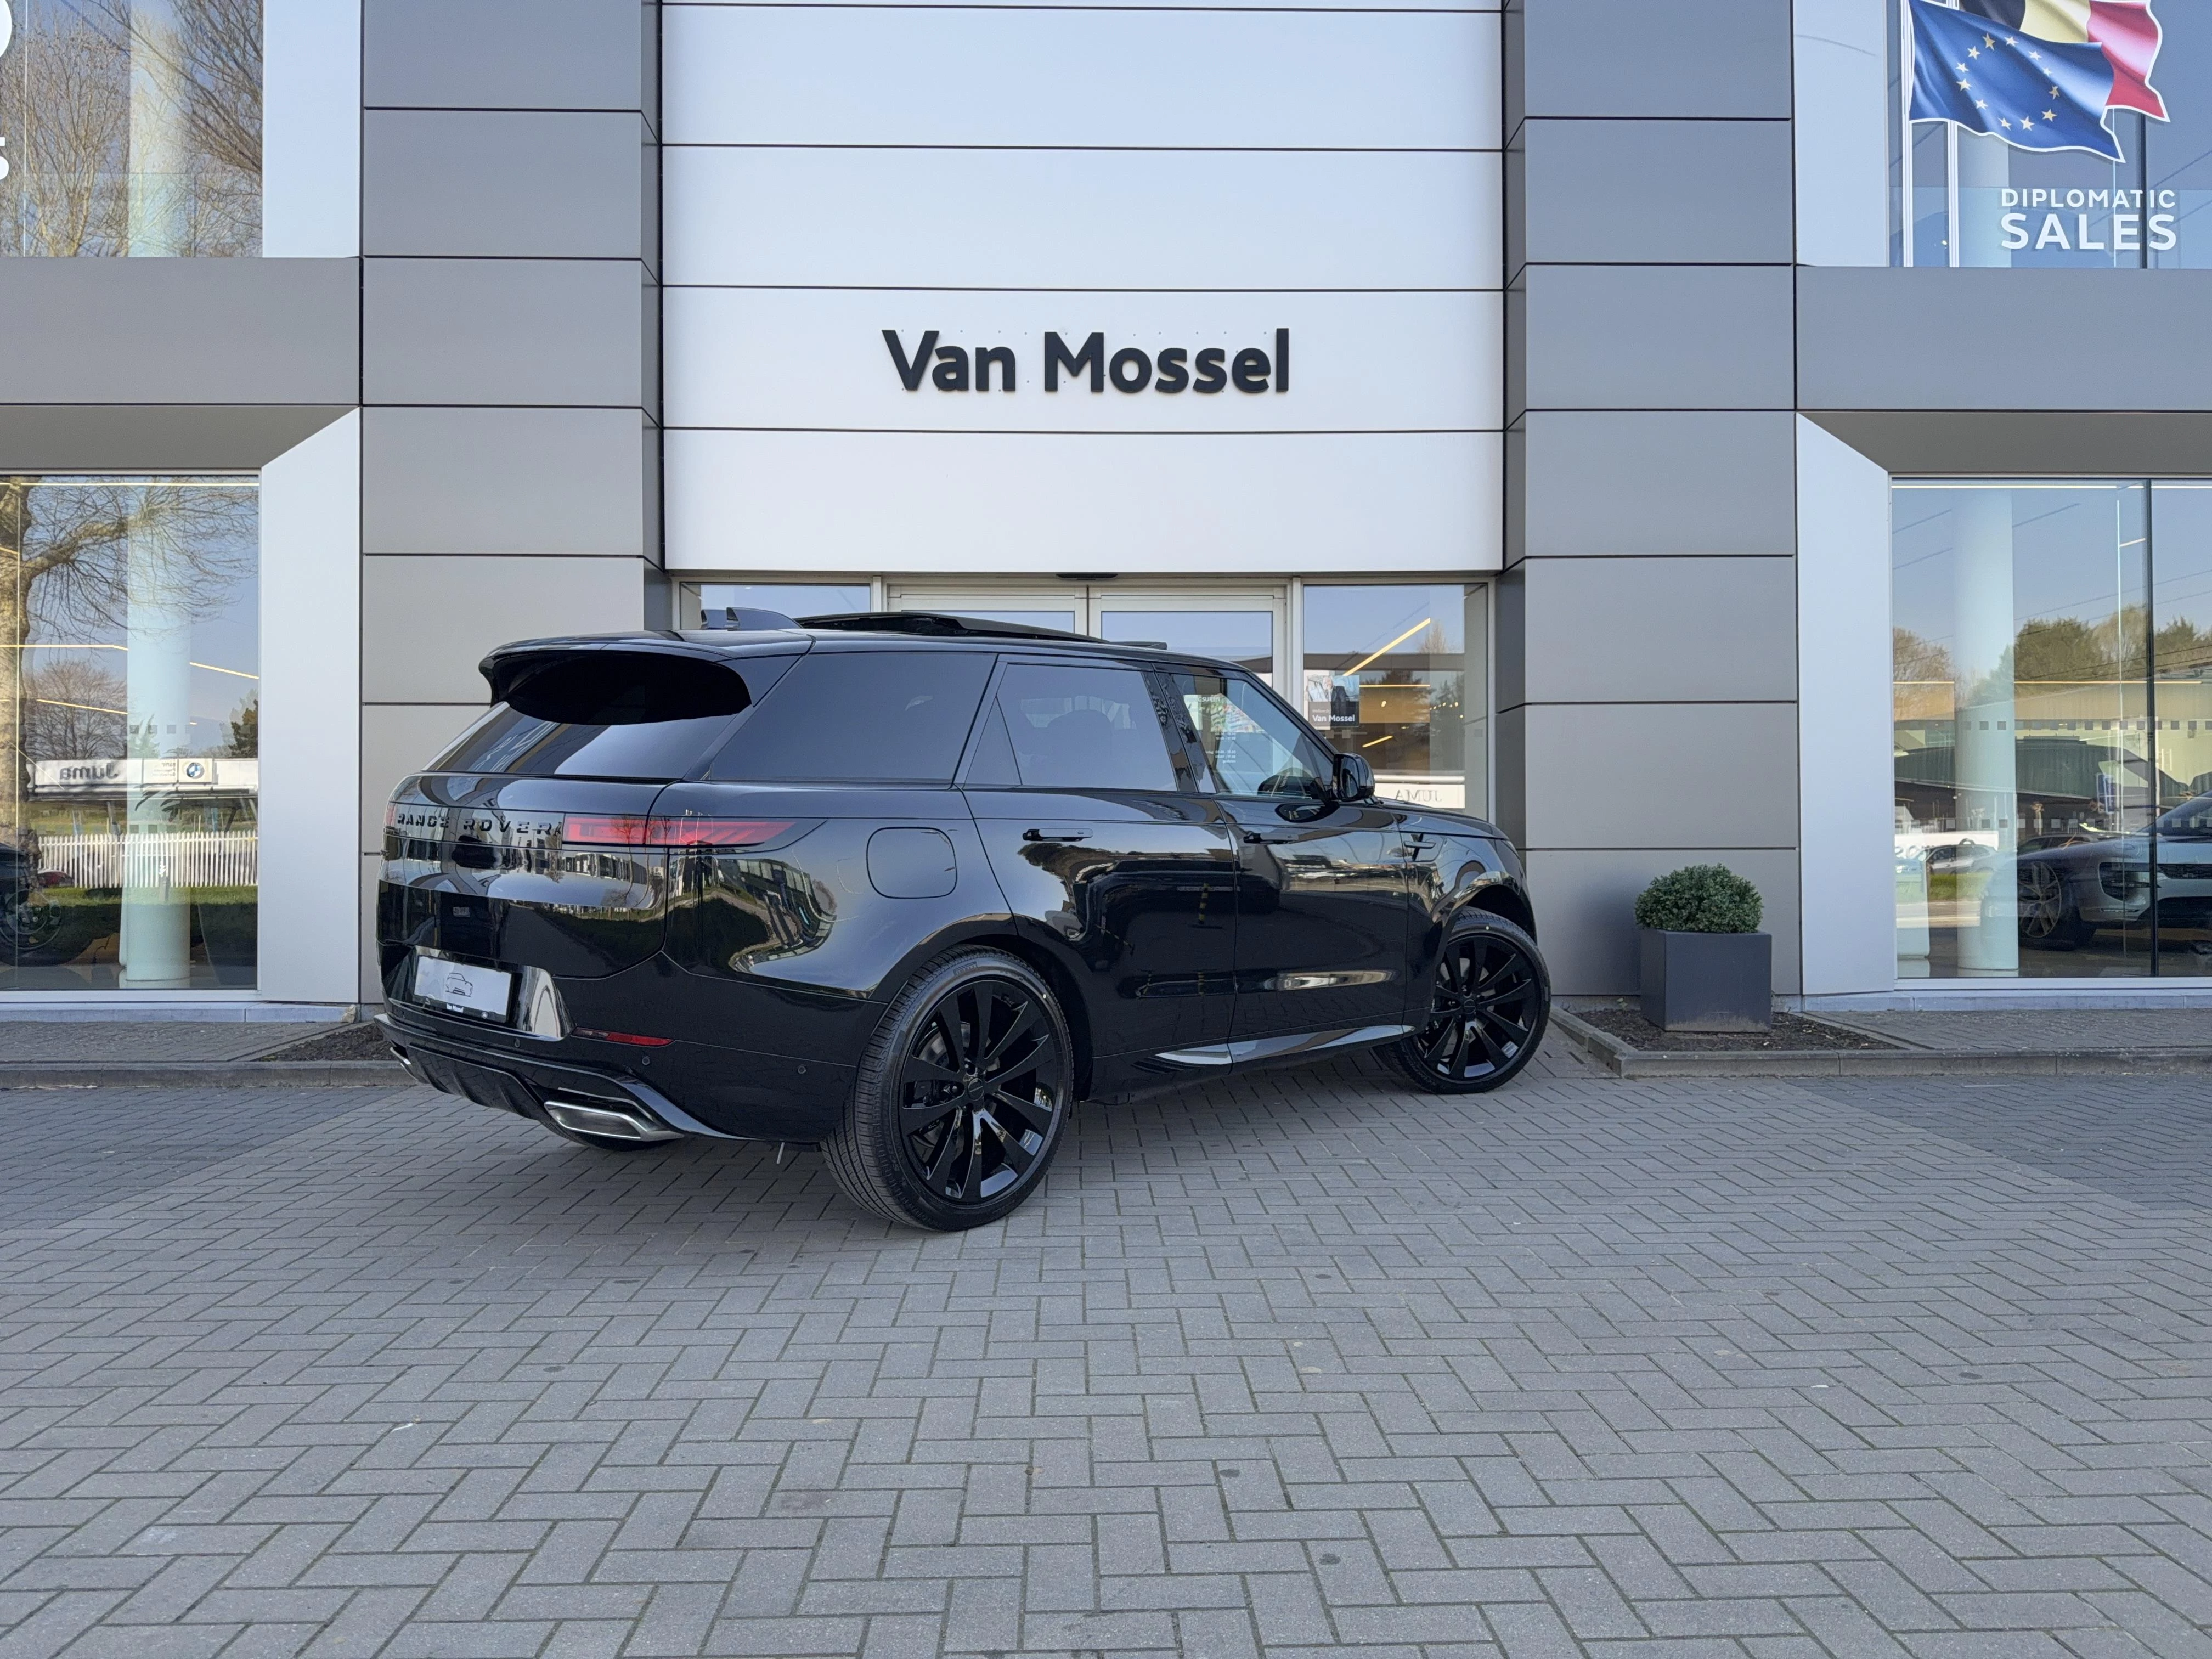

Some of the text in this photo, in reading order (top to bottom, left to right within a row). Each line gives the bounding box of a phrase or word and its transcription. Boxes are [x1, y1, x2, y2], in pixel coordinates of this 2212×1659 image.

[2001, 189, 2176, 208] DIPLOMATIC
[2001, 213, 2177, 250] SALES
[881, 328, 1290, 394] Van Mossel
[1328, 714, 1355, 722] Mossel
[397, 814, 552, 835] RANGE ROVER
